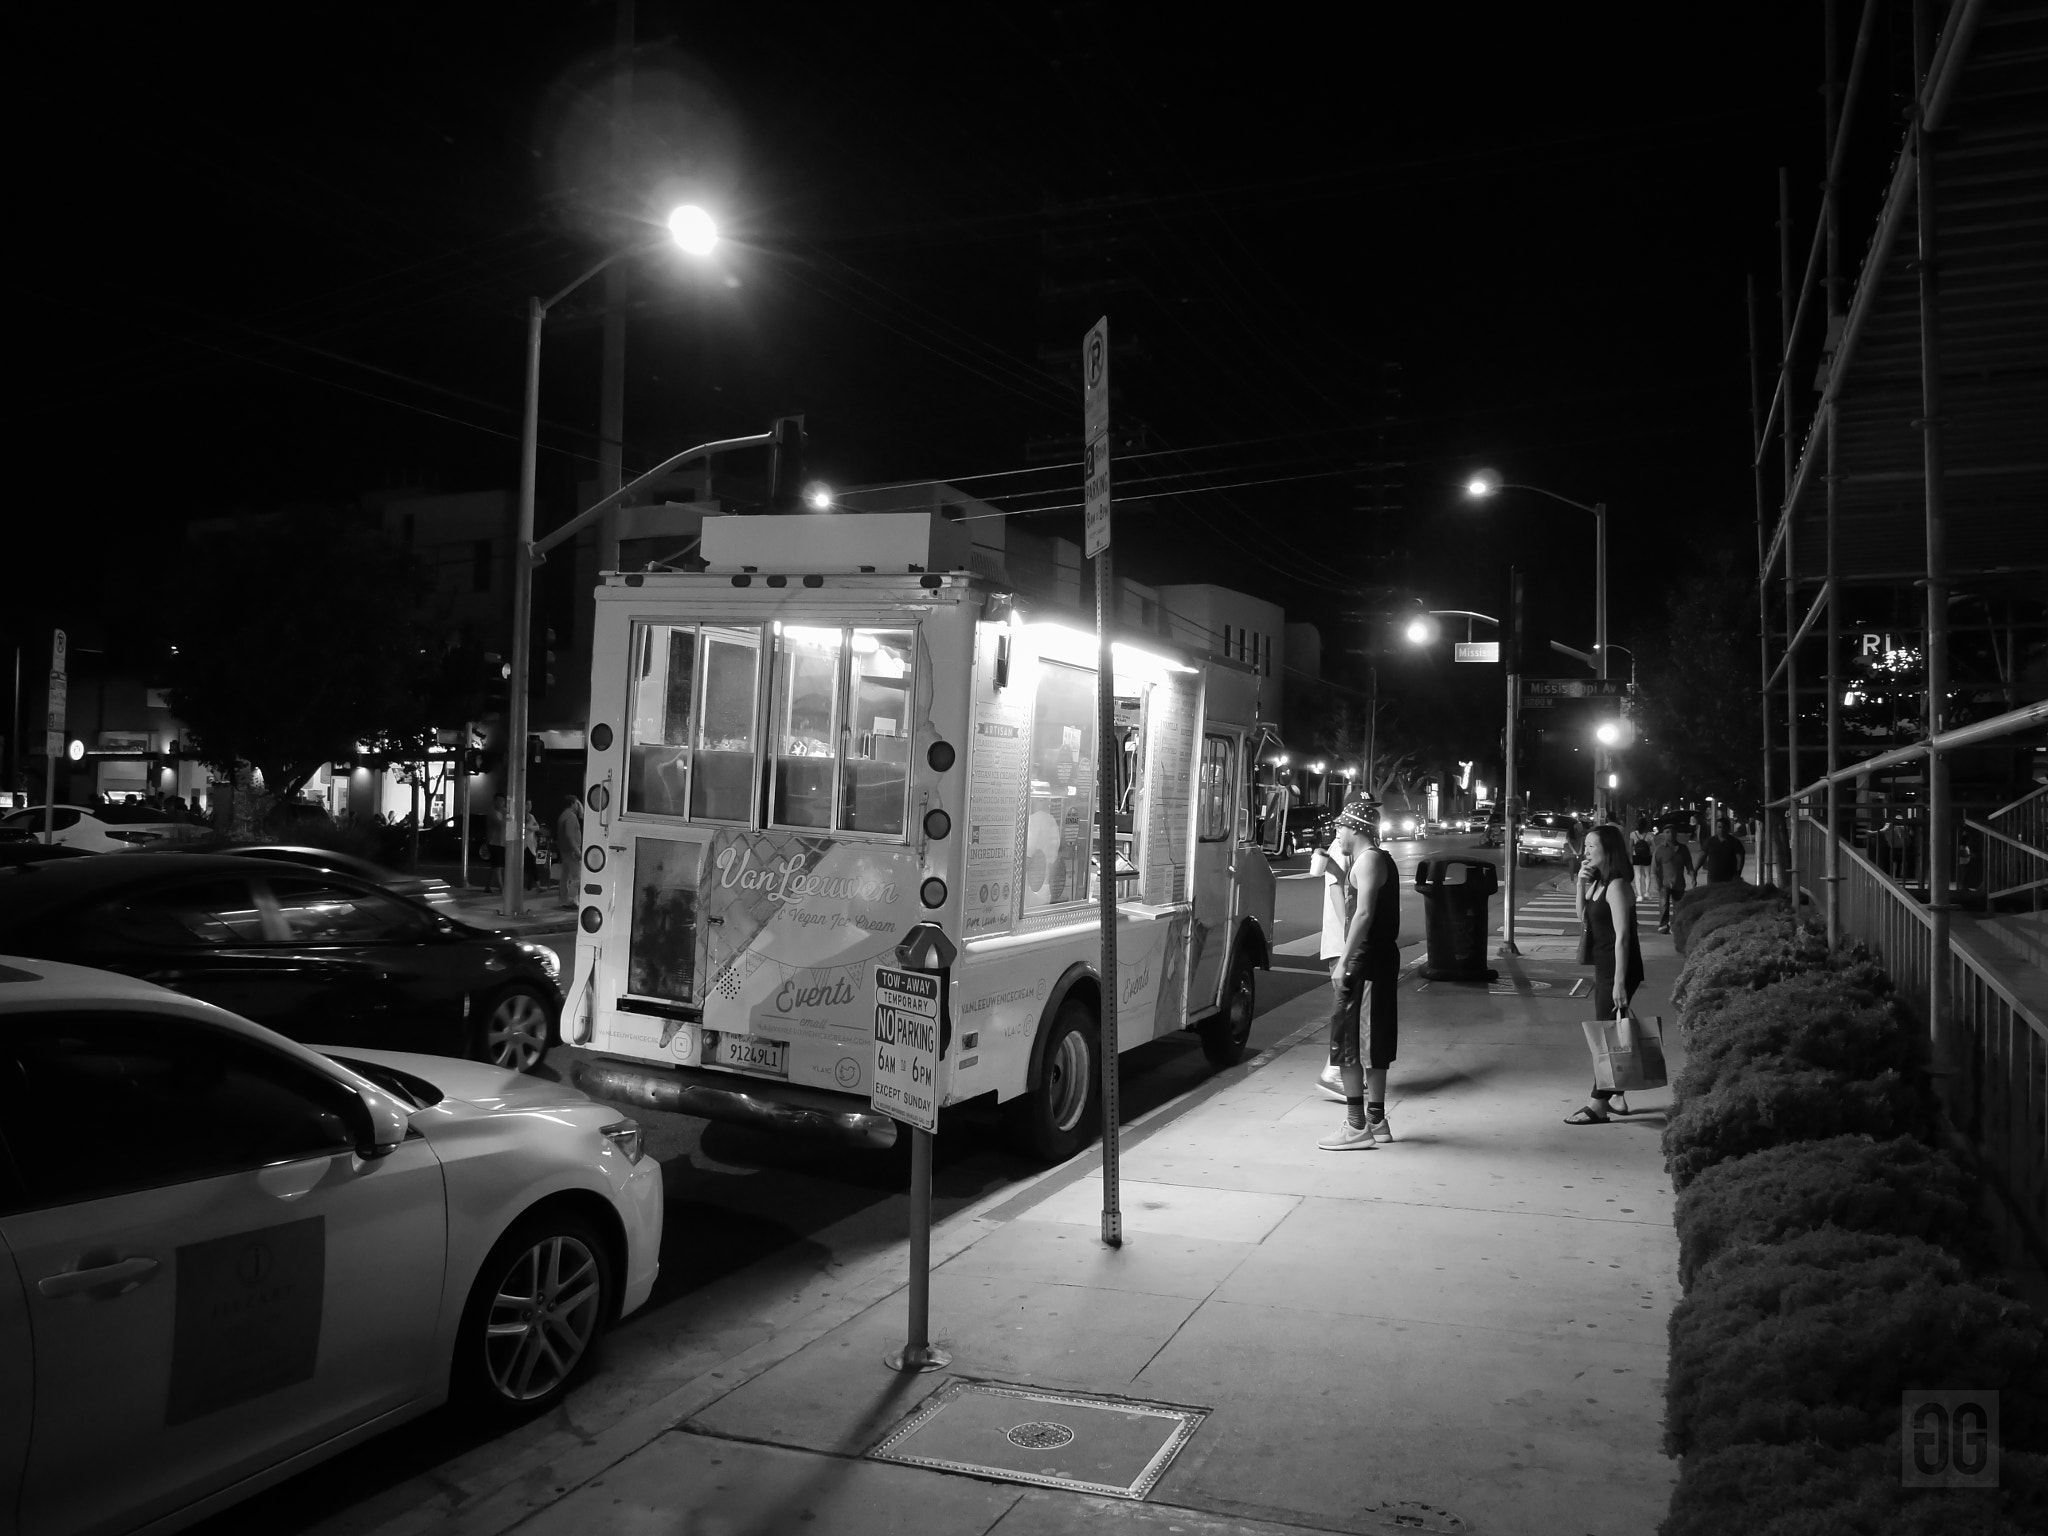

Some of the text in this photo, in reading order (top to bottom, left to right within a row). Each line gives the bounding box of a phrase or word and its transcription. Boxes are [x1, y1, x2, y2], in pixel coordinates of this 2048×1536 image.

[1087, 450, 1092, 475] 2
[1086, 471, 1108, 506] PARKING
[1602, 682, 1616, 694] Av
[984, 725, 1013, 737] ARTISAN
[969, 848, 1013, 859] INGREDIENTS
[716, 847, 900, 904] Van Leeuwen
[789, 908, 827, 928] Vegan
[831, 913, 851, 931] Ice
[855, 914, 896, 933] Cream
[775, 976, 855, 1013] Events
[882, 972, 930, 995] TOW-AWAY
[883, 991, 928, 1013] TEMPORARY
[799, 1017, 830, 1030] email
[877, 1007, 934, 1054] NO PARKING
[730, 1044, 778, 1067] 91249L1
[877, 1045, 896, 1074] 6AM
[912, 1056, 932, 1087] 6PM
[875, 1082, 932, 1112] EXCEPT SUNDAY
